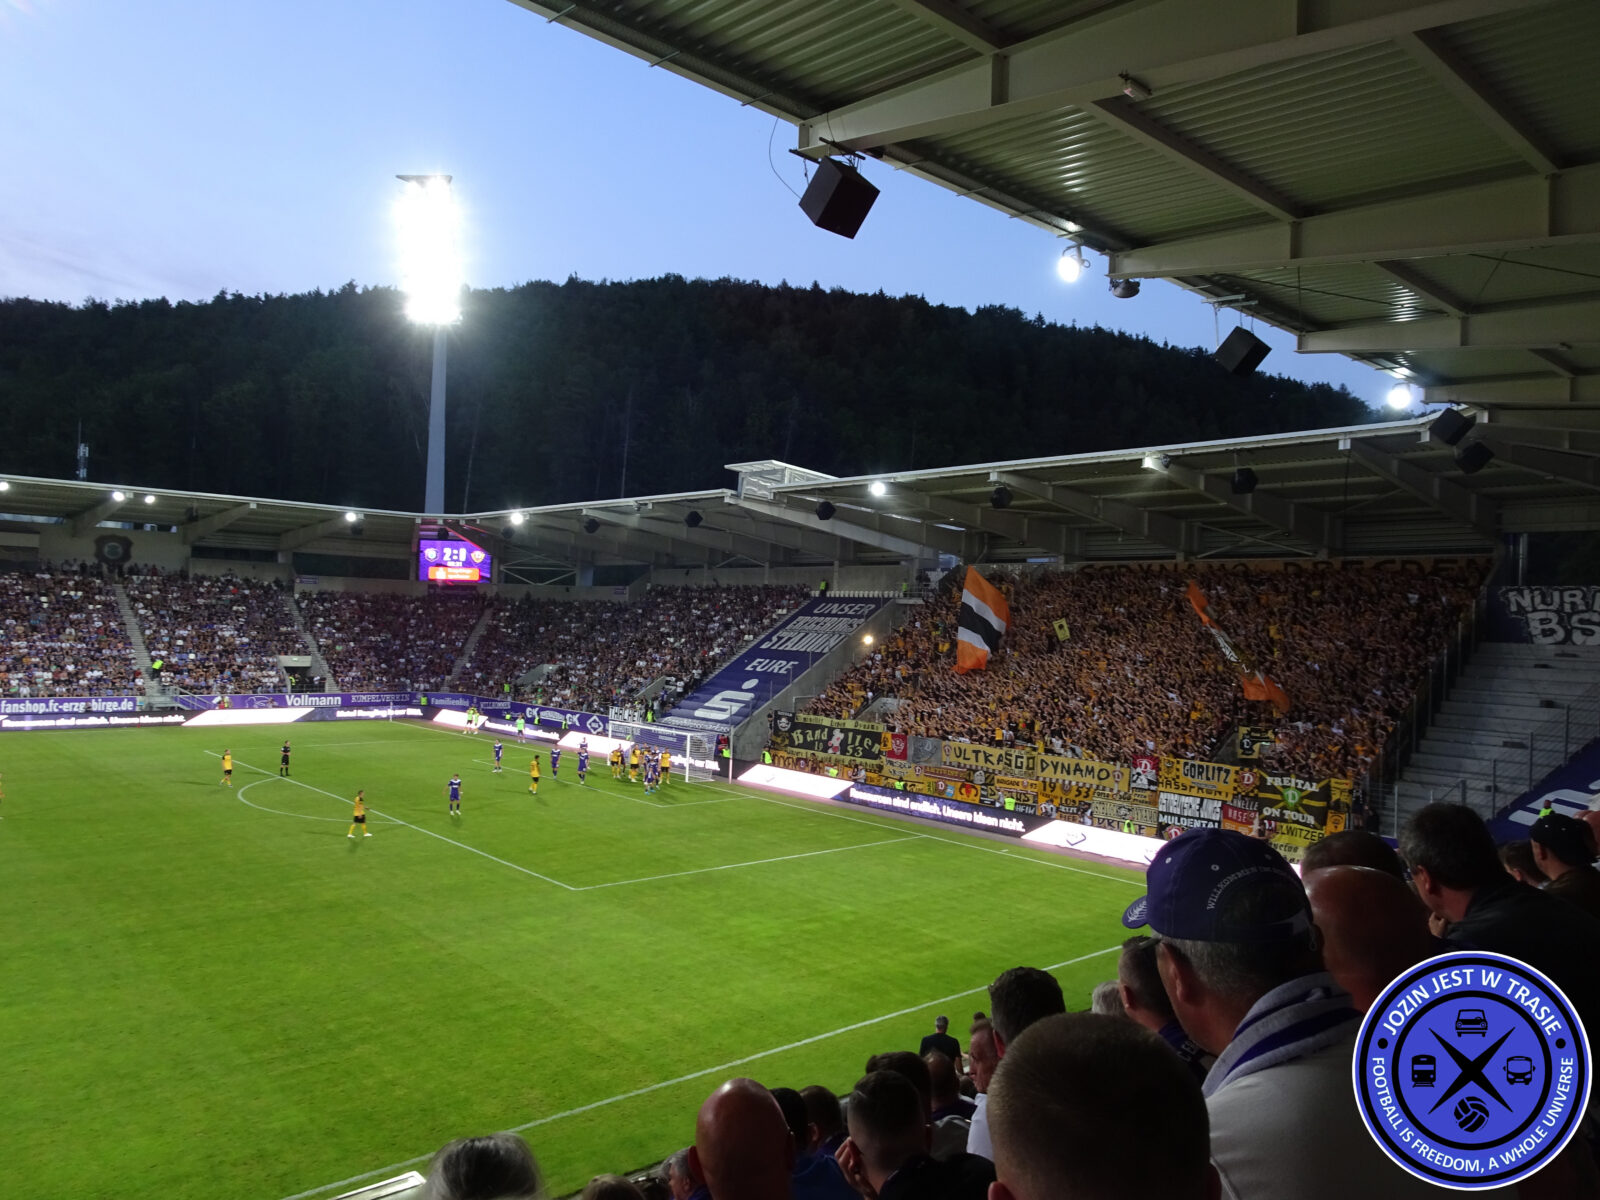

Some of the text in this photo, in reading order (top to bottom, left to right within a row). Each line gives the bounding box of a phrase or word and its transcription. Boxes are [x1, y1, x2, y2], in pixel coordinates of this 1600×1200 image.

[813, 603, 875, 616] UNSER
[744, 658, 800, 674] EURE
[1, 698, 134, 714] fanshop.fc-erzgbirge.de
[285, 694, 342, 707] Vollmann
[565, 713, 581, 726] GK
[1040, 758, 1111, 781] DYNAMO
[1266, 776, 1320, 792] FREITAL
[1262, 807, 1315, 824] ON TOUR
